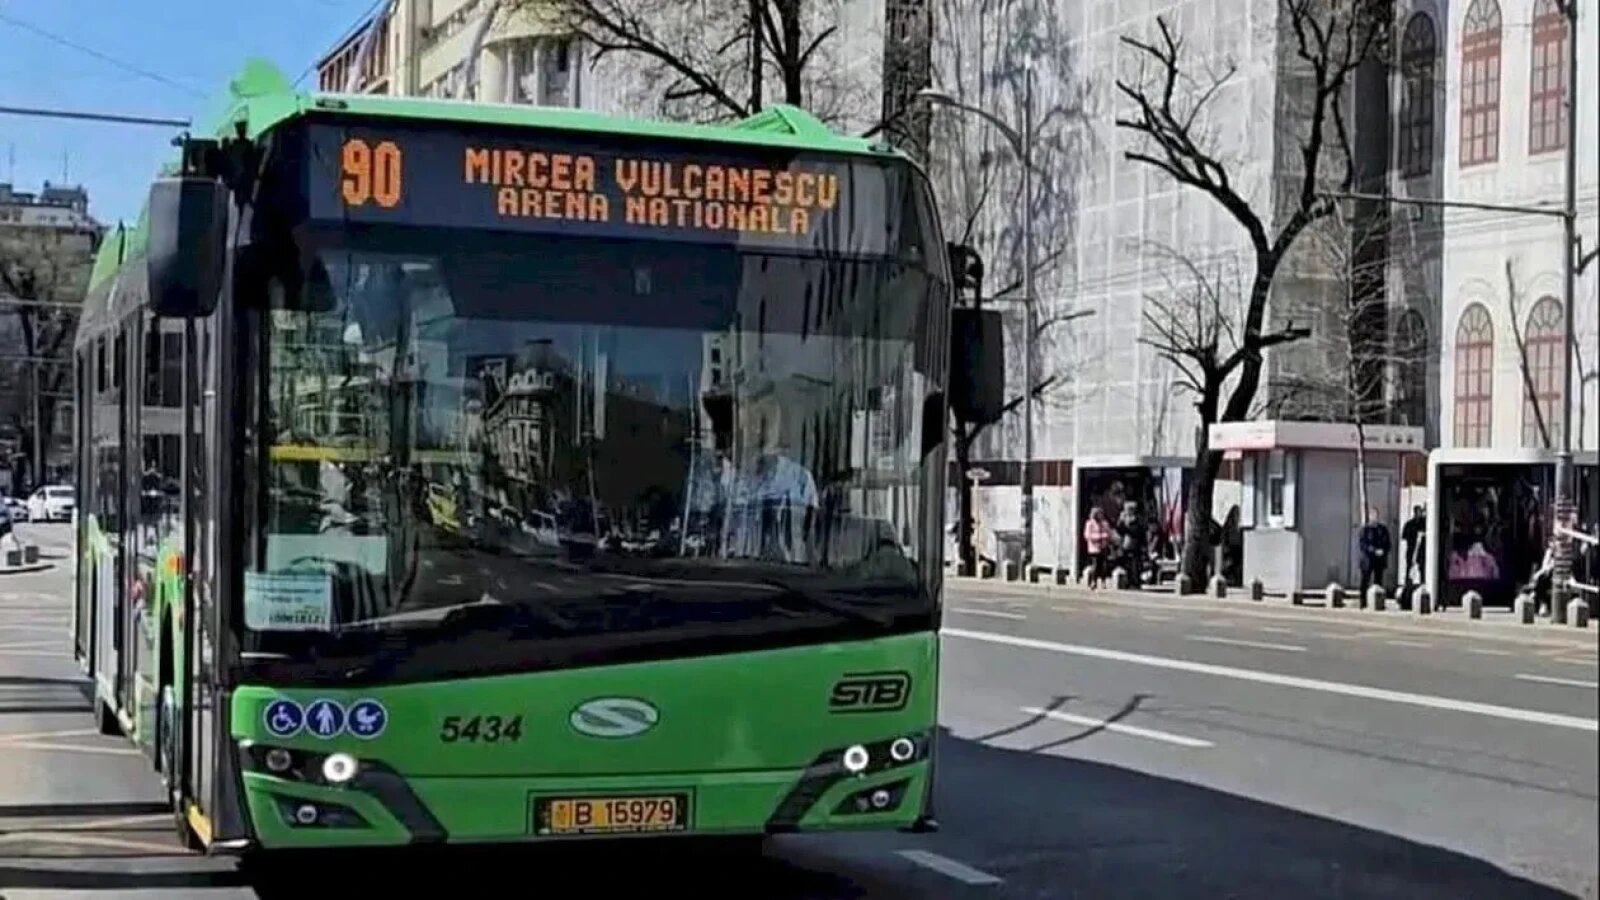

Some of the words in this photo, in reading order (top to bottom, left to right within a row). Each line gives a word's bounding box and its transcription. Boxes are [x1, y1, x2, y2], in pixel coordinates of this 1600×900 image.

[342, 138, 402, 208] 90
[465, 147, 595, 191] MIRCEA
[615, 158, 838, 209] VULCANESCU
[498, 187, 609, 222] ARENA
[625, 196, 810, 235] NATIONALA
[829, 678, 906, 707] STB
[439, 715, 524, 743] 5434
[575, 802, 592, 825] B
[605, 800, 674, 824] 15979
